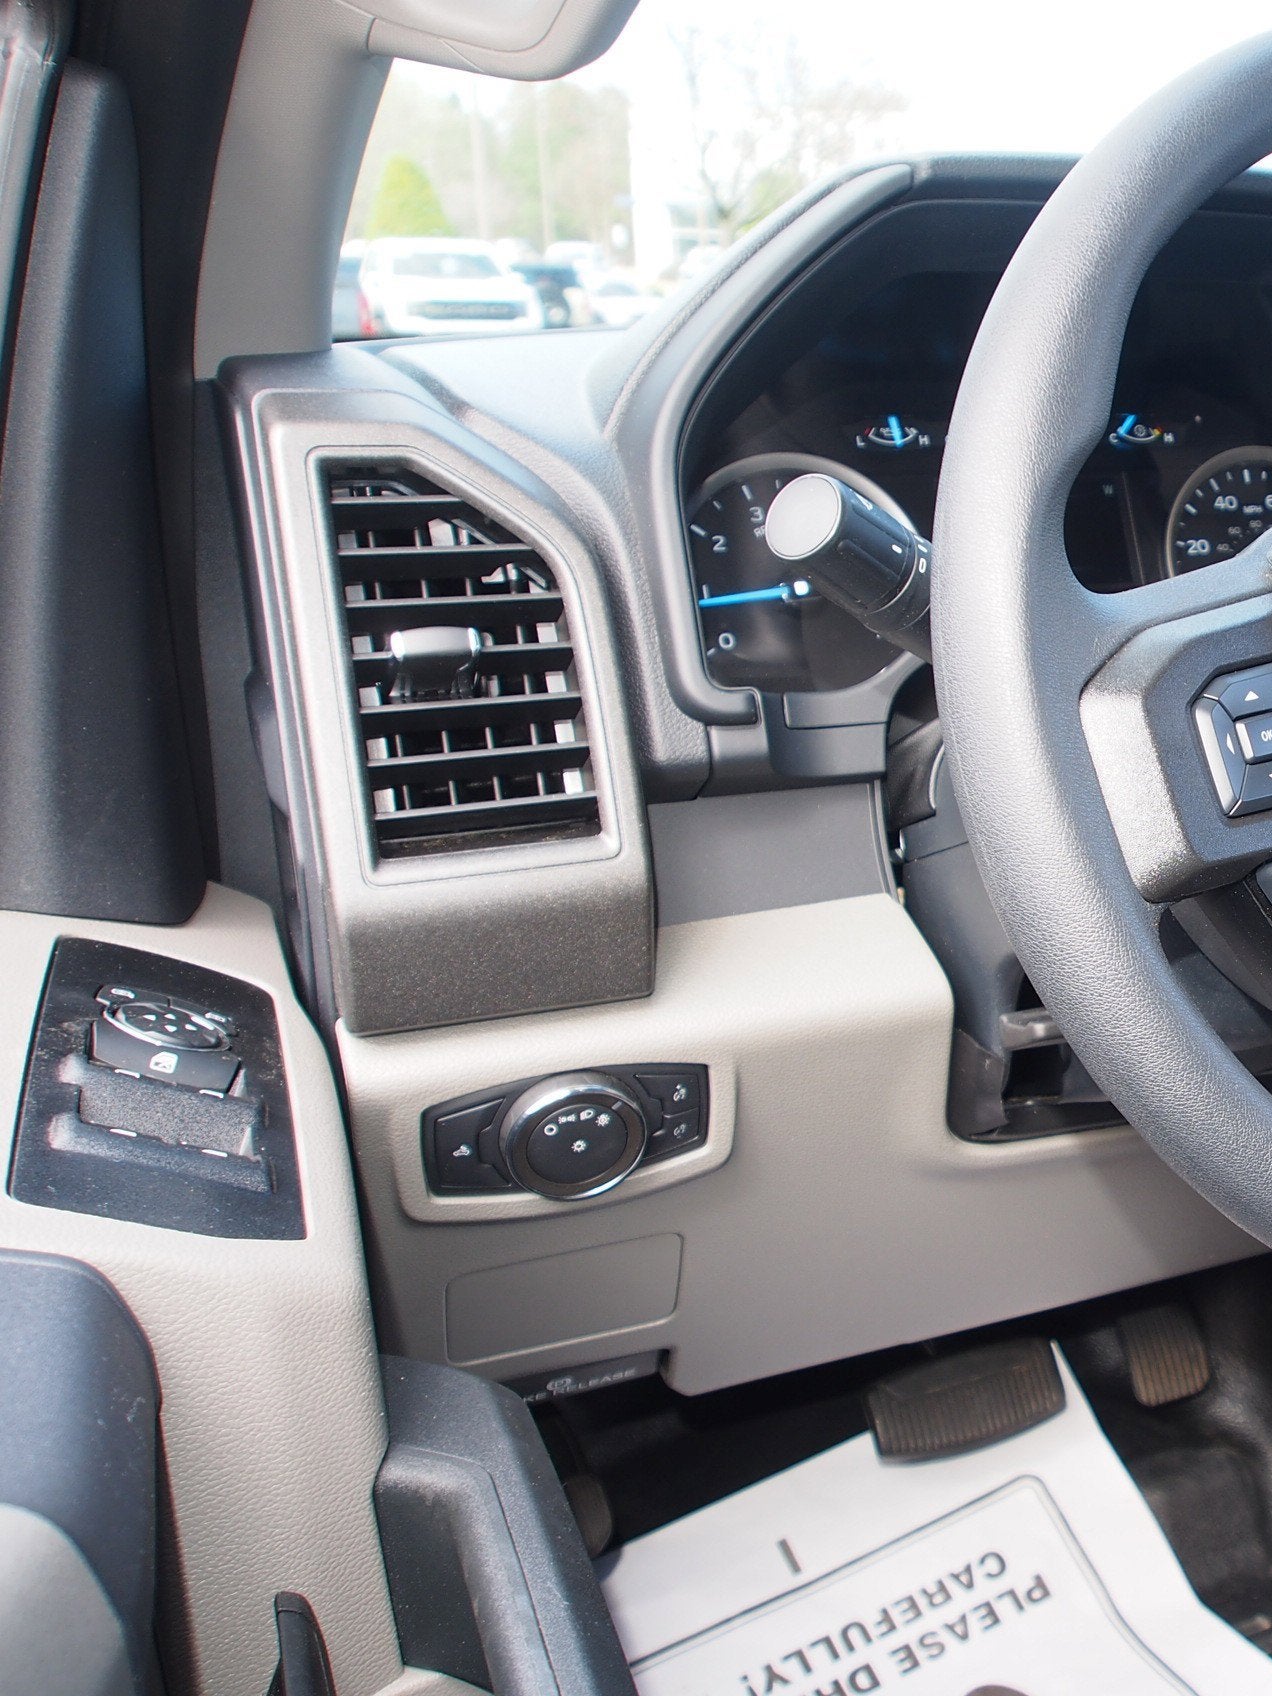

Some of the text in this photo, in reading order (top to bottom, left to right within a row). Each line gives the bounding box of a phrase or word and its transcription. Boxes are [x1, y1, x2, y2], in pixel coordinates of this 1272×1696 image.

[1214, 495, 1238, 511] 40
[749, 506, 764, 522] 3
[712, 535, 727, 552] 2
[1186, 539, 1210, 556] 20
[552, 1368, 637, 1396] RELEASE
[740, 1552, 1008, 1696] CAREFULLY!
[888, 1573, 1052, 1676] PLEASE
